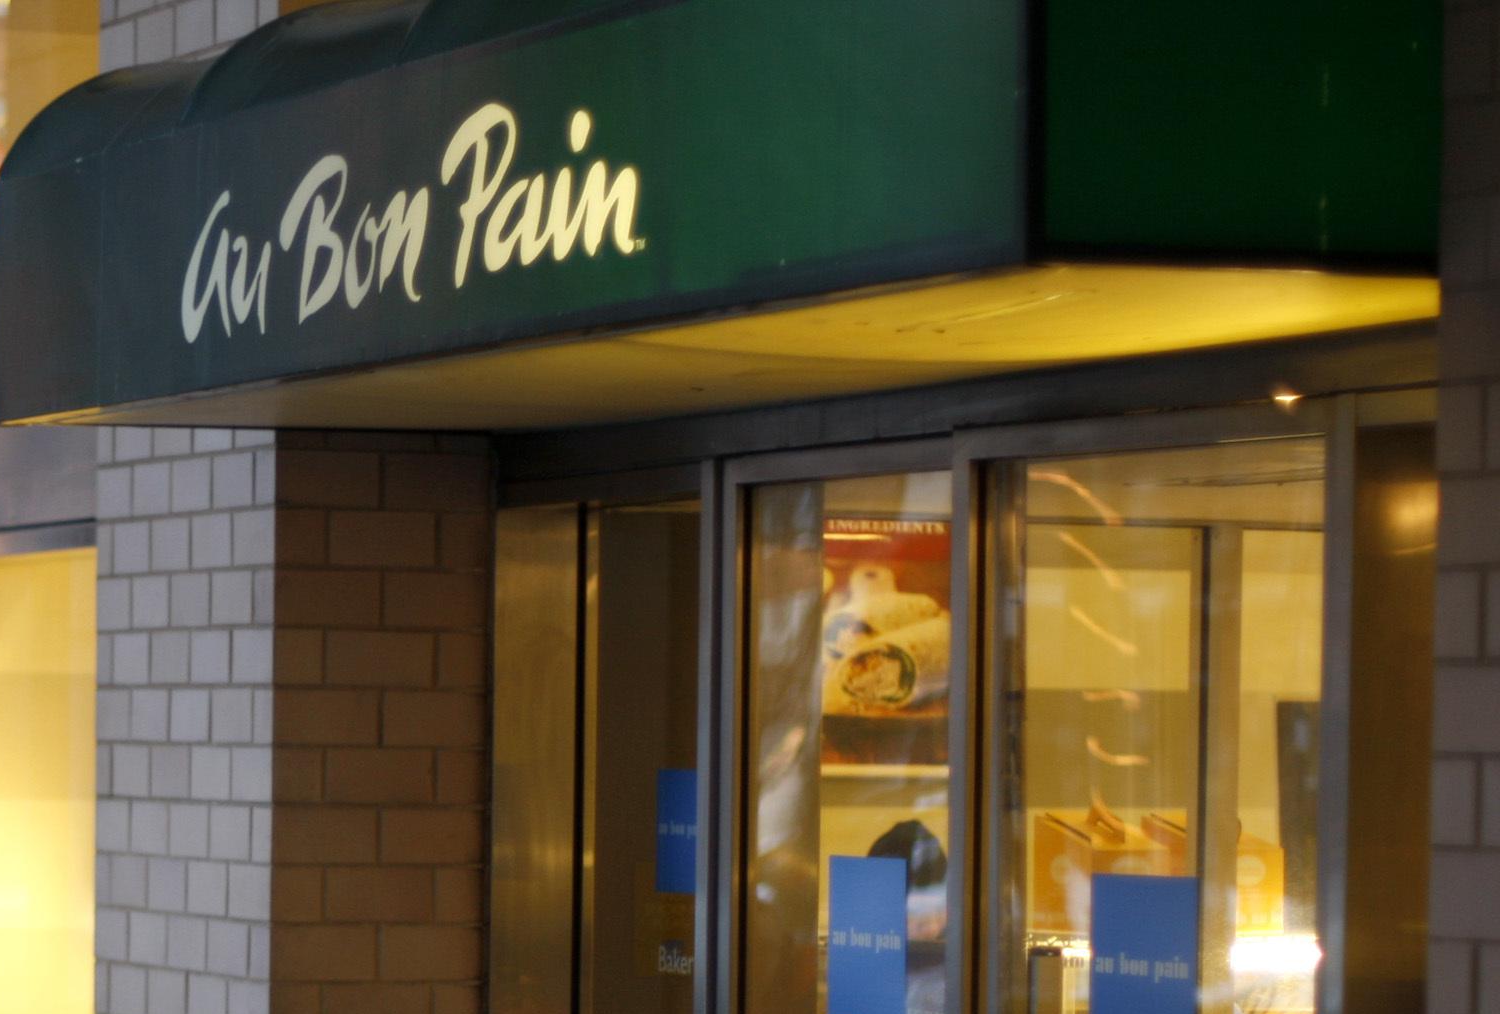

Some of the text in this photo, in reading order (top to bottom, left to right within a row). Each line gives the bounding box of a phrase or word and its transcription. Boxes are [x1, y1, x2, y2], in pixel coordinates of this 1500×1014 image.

[279, 154, 429, 325] Bon
[440, 102, 637, 289] Pain
[827, 518, 947, 535] INGREDIENTS
[658, 944, 694, 975] Baker
